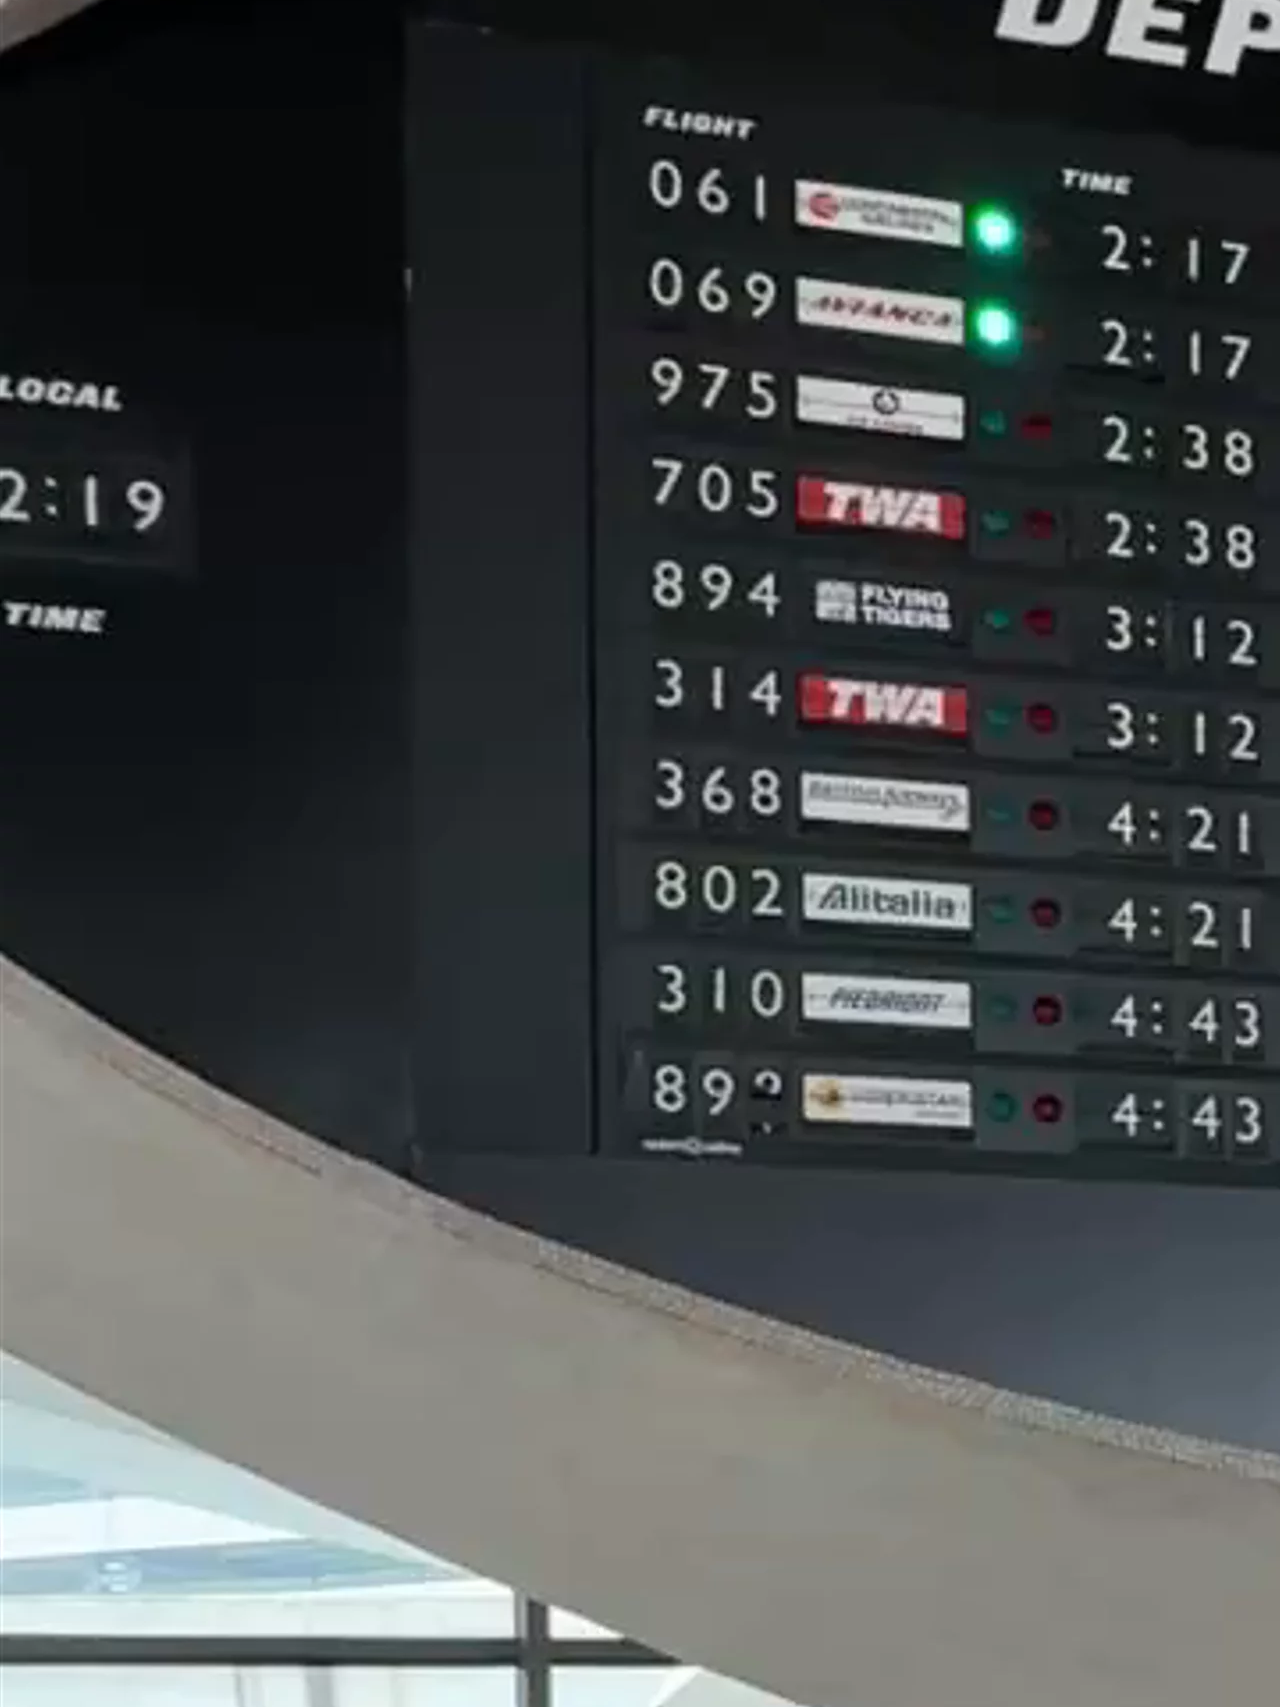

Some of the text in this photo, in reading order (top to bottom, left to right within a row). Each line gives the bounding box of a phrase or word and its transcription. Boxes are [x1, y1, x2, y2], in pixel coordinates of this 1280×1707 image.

[643, 106, 755, 140] FLIGHT
[649, 160, 766, 220] 061
[1102, 224, 1250, 284] 2:17
[1062, 168, 1131, 195] TIME
[650, 258, 776, 319] 069
[1102, 319, 1251, 380] 2:17
[0, 375, 121, 411] LOCAL
[651, 358, 777, 419] 975
[1103, 415, 1253, 476] 2:38
[652, 458, 778, 518] 705
[824, 483, 944, 534] TWA
[1105, 512, 1255, 569] 2:38
[4, 602, 106, 633] TIME
[653, 560, 780, 617] 894
[861, 583, 949, 611] FLYING
[1106, 605, 1257, 666] 3:12
[861, 606, 951, 633] TIGERS
[655, 659, 782, 716] 314
[828, 681, 945, 726] TWA
[1107, 702, 1258, 760] 3:12
[656, 760, 781, 815] 368
[1107, 802, 1249, 853] 4:21
[655, 861, 783, 916] 802
[816, 883, 957, 922] Alitalia
[1108, 899, 1251, 949] 4:21
[658, 964, 784, 1018] 310
[1110, 995, 1260, 1047] 4:43
[1112, 1093, 1261, 1143] 4:43
